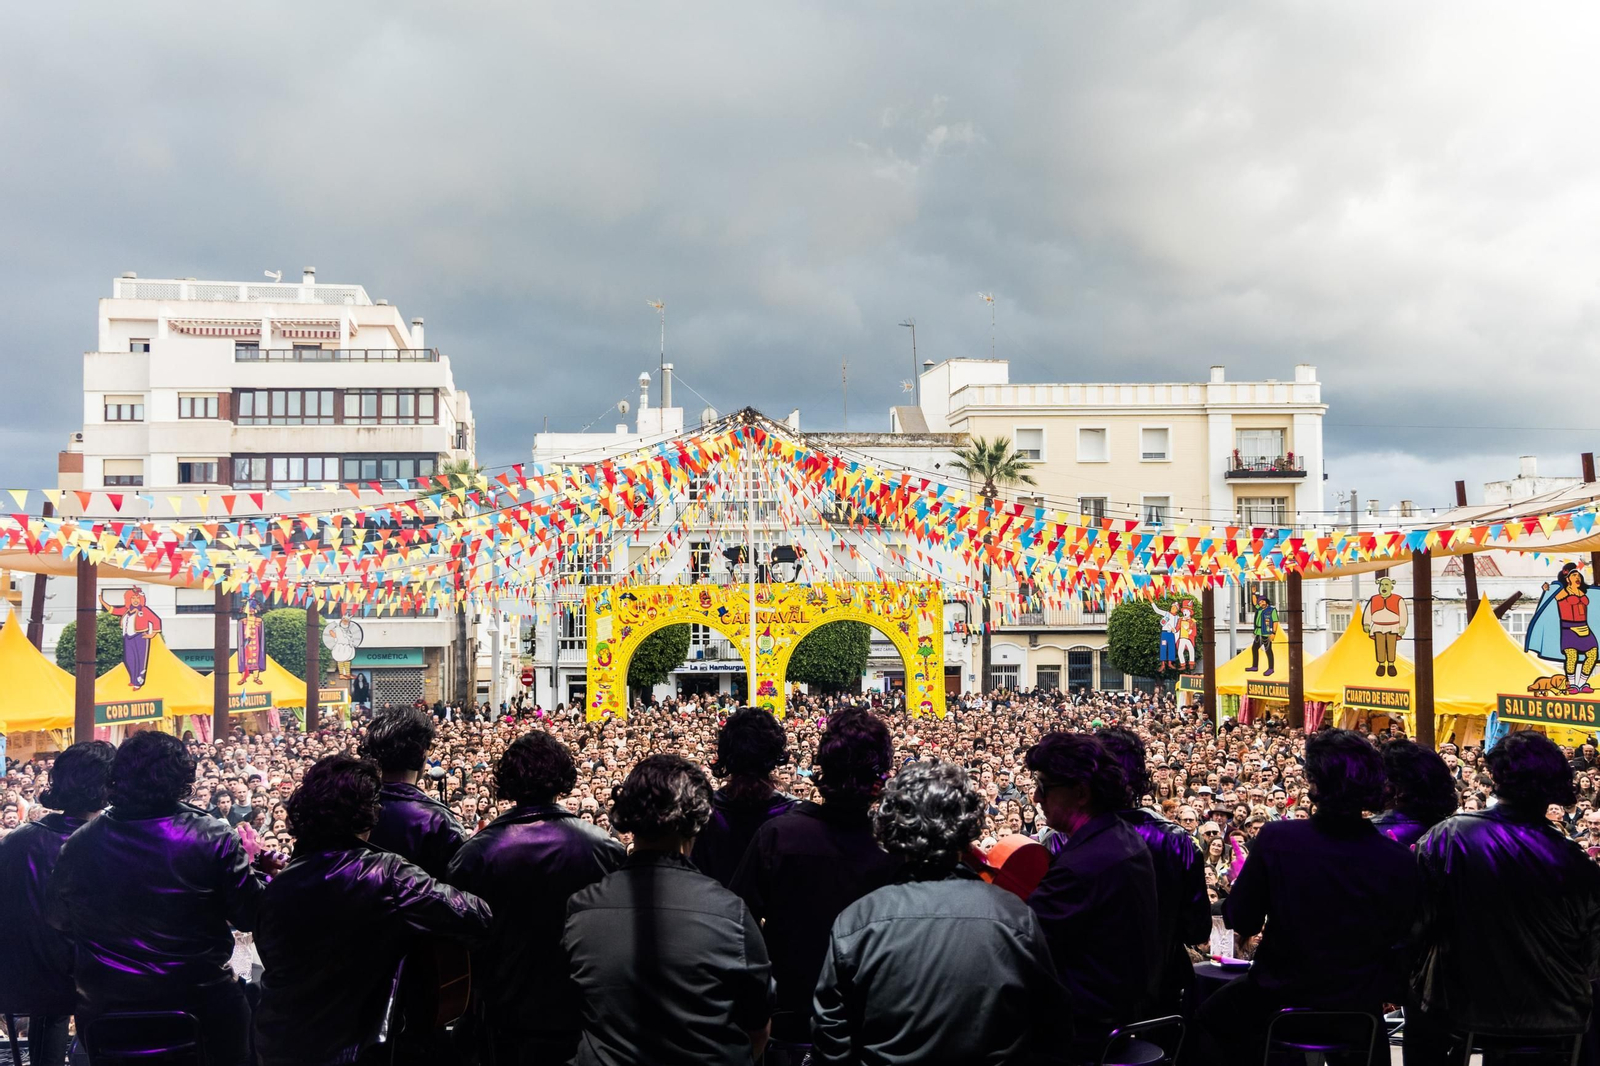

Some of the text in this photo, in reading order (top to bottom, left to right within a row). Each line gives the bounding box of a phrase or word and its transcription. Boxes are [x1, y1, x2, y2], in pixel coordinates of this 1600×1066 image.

[721, 611, 809, 625] CARNAVAL
[1249, 683, 1264, 696] SABOR
[1264, 685, 1269, 697] A
[1346, 689, 1409, 707] CUARTO DE ENSAYO
[229, 696, 240, 708] LOS
[106, 702, 156, 720] CORO MIXTO
[1505, 698, 1595, 723] SAL DE COPLAS
